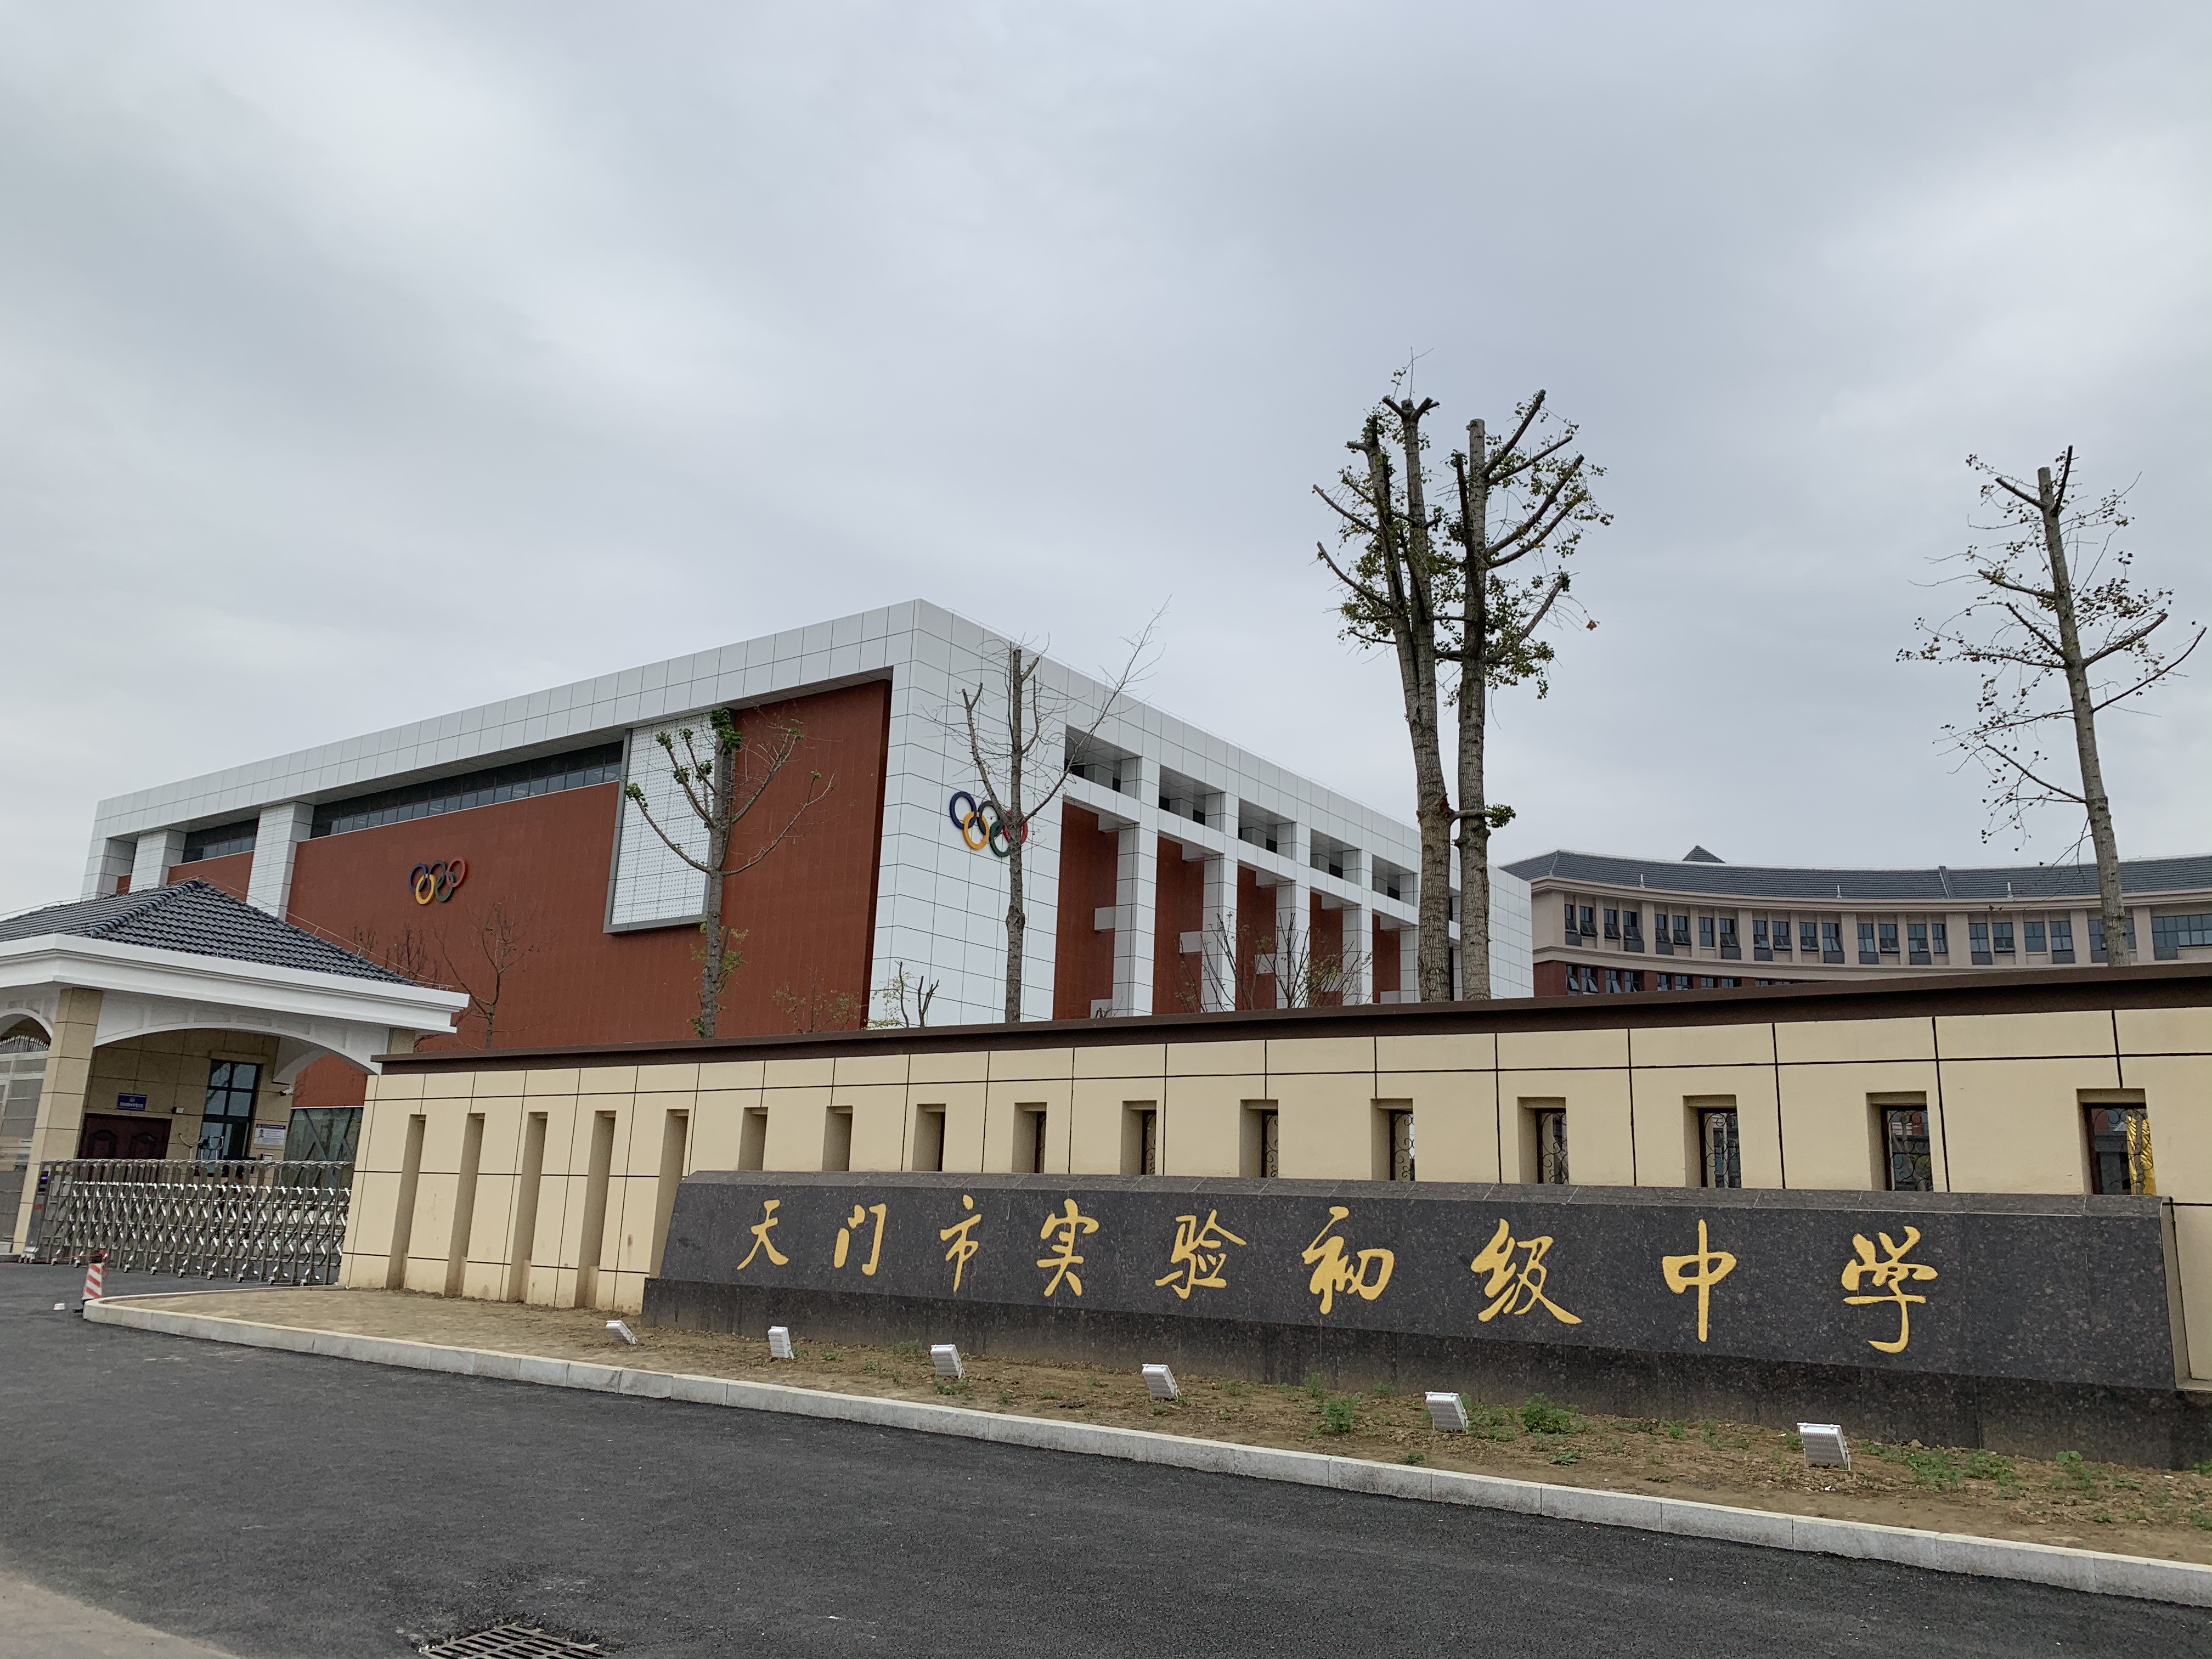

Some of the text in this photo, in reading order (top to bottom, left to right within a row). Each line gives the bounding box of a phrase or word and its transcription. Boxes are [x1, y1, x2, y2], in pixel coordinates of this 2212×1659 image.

[737, 1195, 1939, 1353] 天门市实验初级中学
